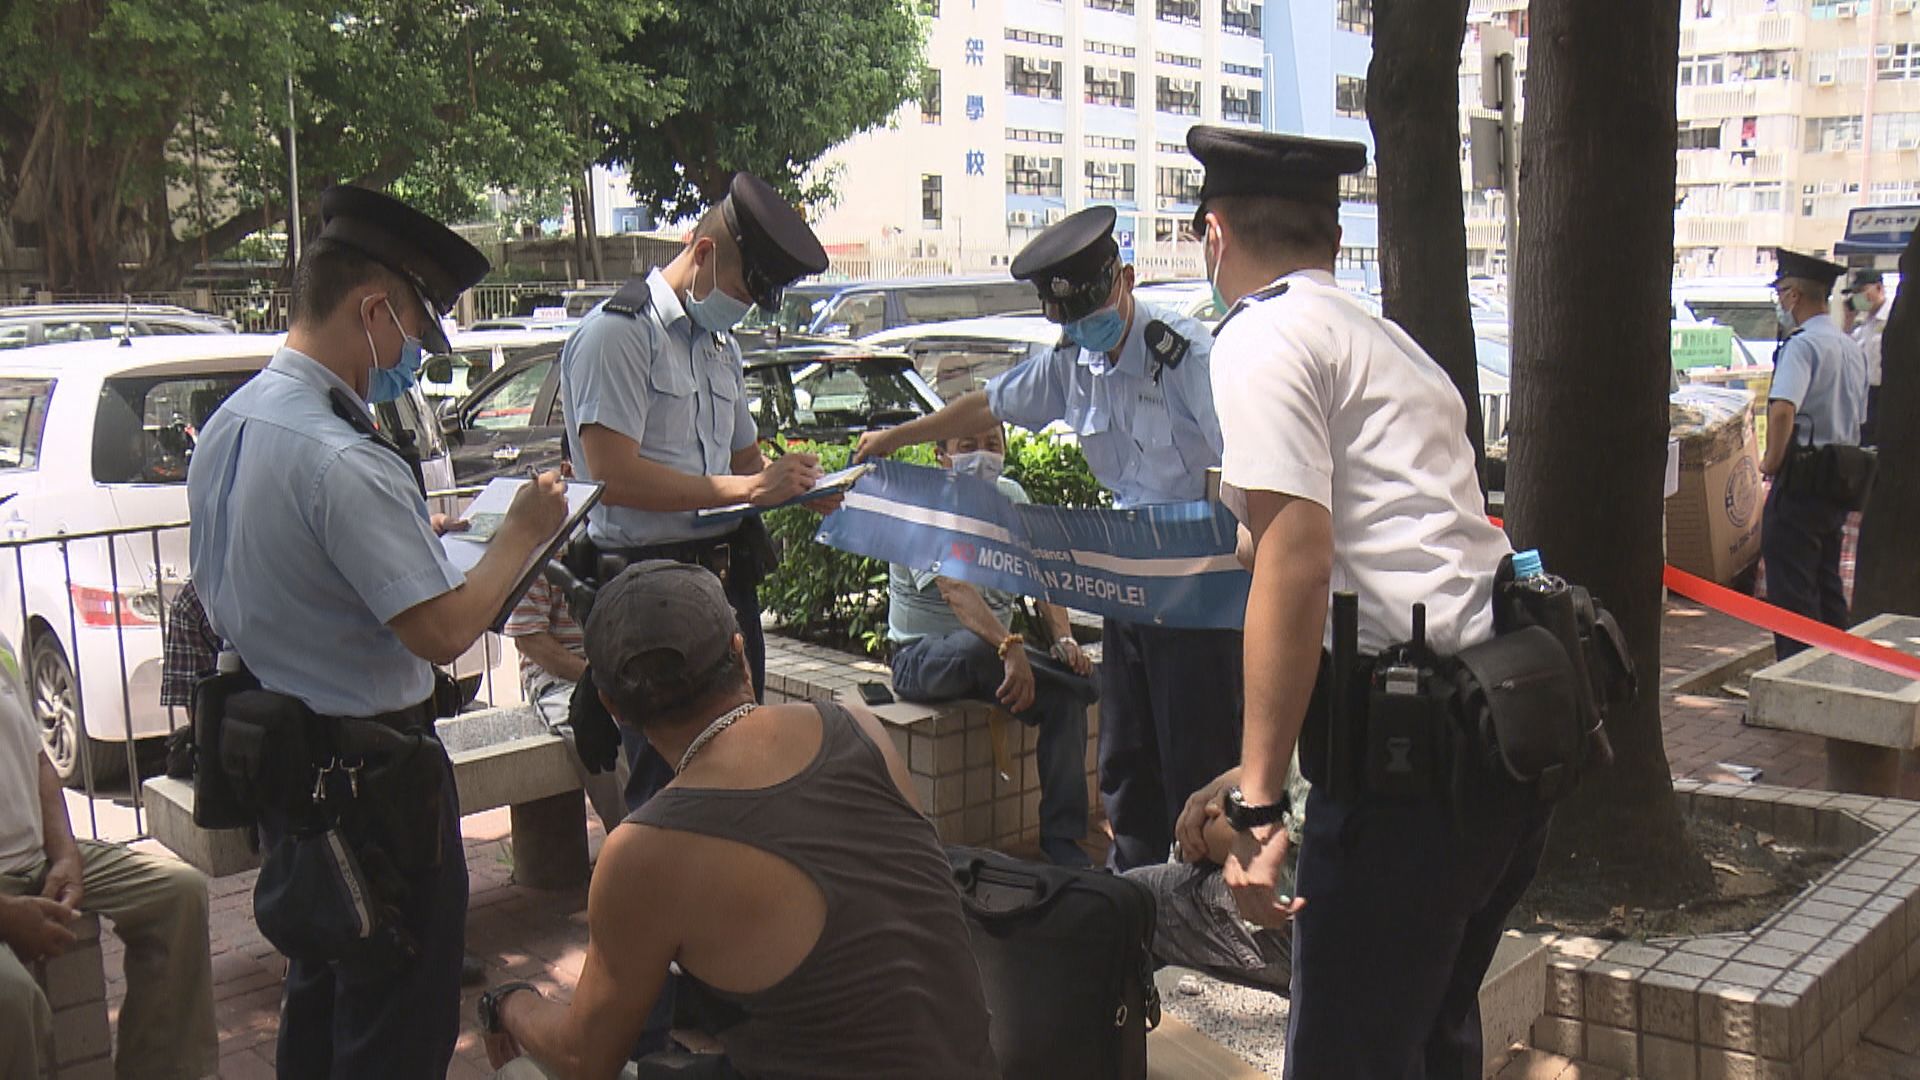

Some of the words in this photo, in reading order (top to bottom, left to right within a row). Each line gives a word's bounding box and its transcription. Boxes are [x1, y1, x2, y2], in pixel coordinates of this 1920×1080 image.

[964, 0, 985, 176] 架學校
[1121, 232, 1130, 246] P
[1136, 256, 1168, 268] UTHERAN
[1171, 256, 1197, 268] SCHOOL
[951, 543, 976, 563] NO
[977, 547, 1024, 576] MORE
[1060, 570, 1074, 590] 2
[1074, 574, 1146, 606] PEOPLE!
